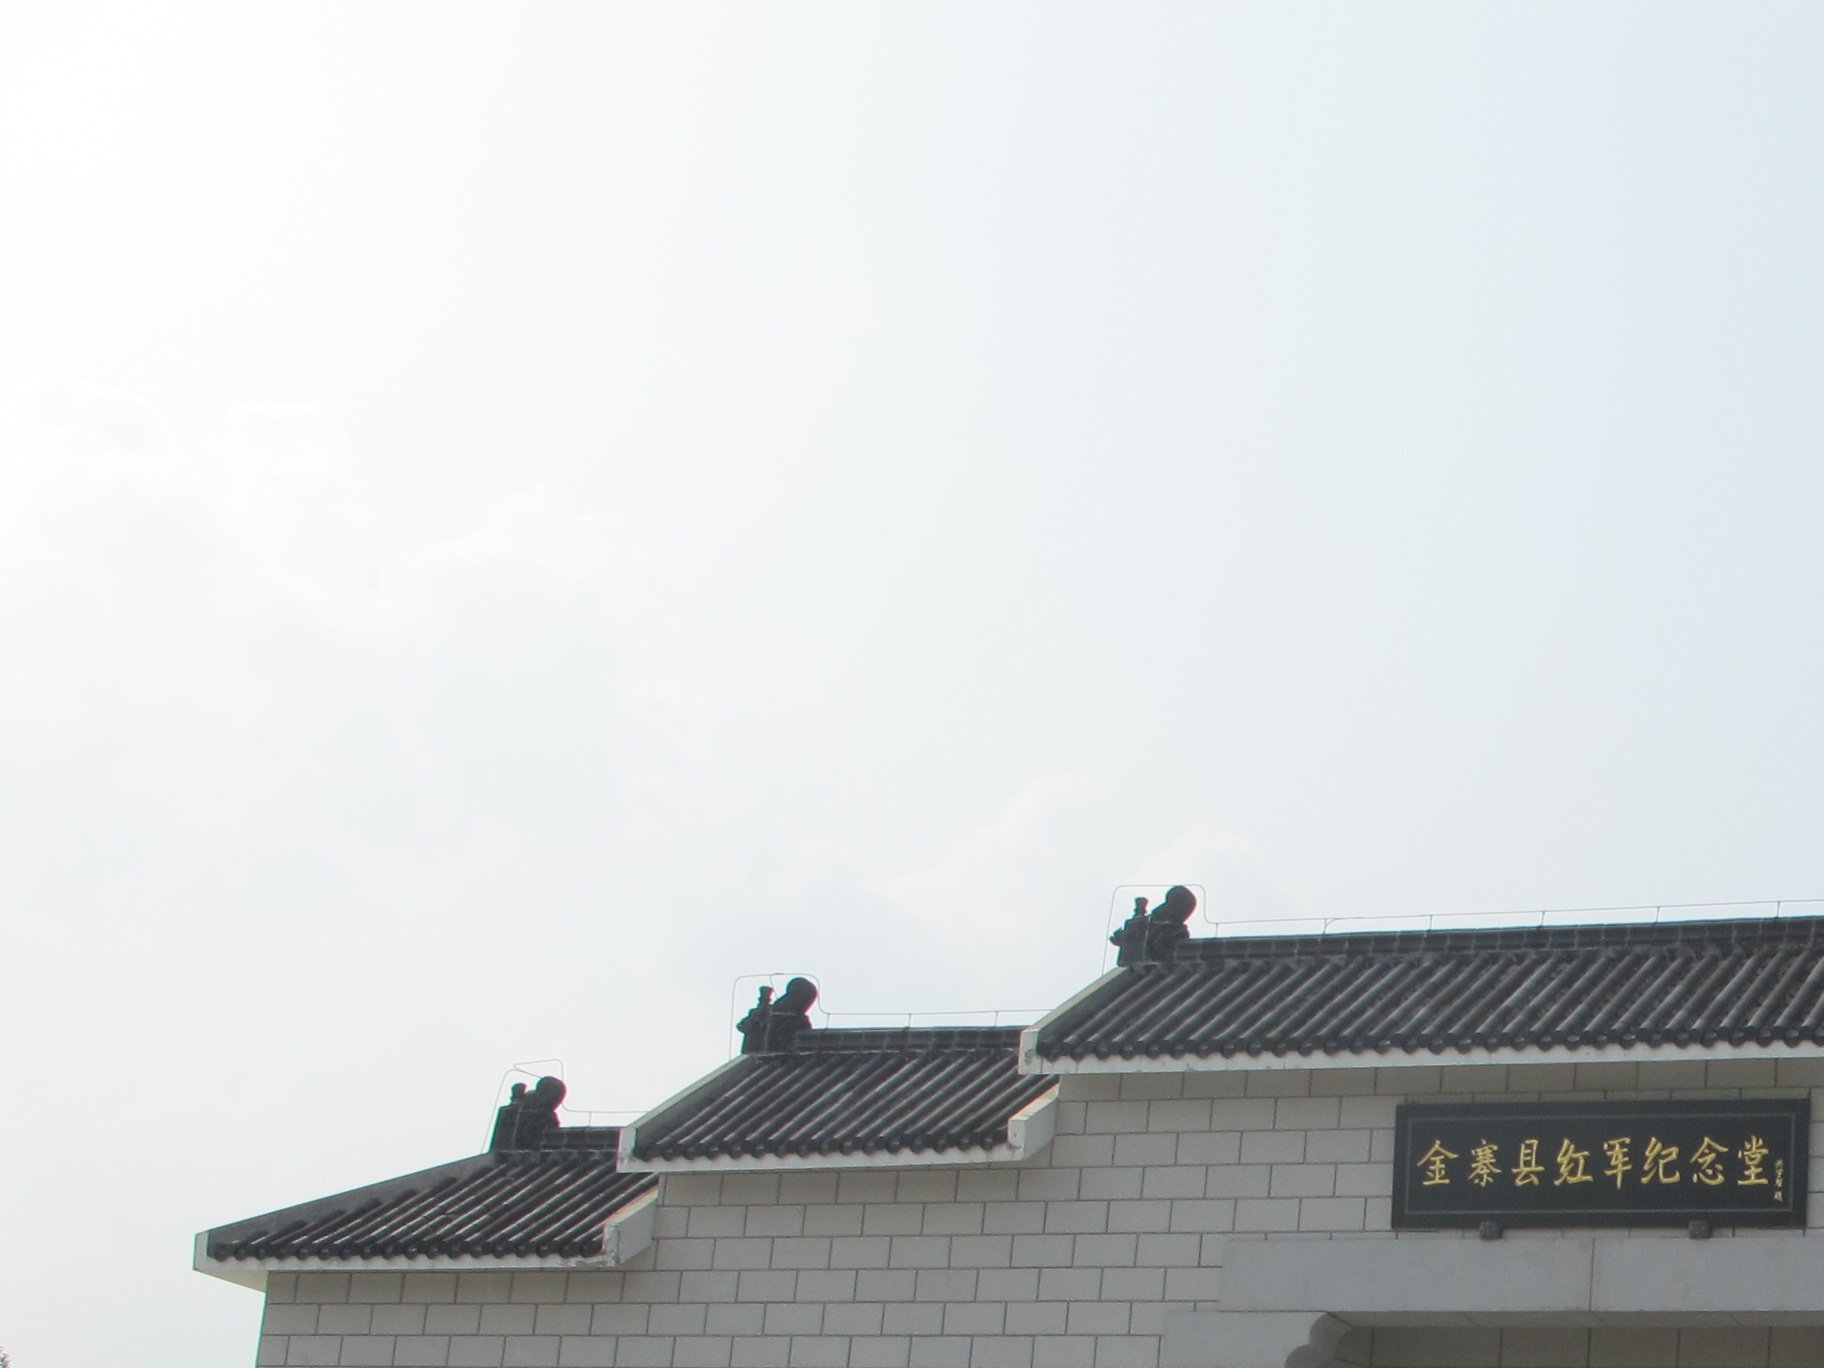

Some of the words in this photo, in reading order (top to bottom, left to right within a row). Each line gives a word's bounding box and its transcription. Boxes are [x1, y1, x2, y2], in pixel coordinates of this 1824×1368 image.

[1416, 1135, 1769, 1190] 金寨县红军纪念堂
